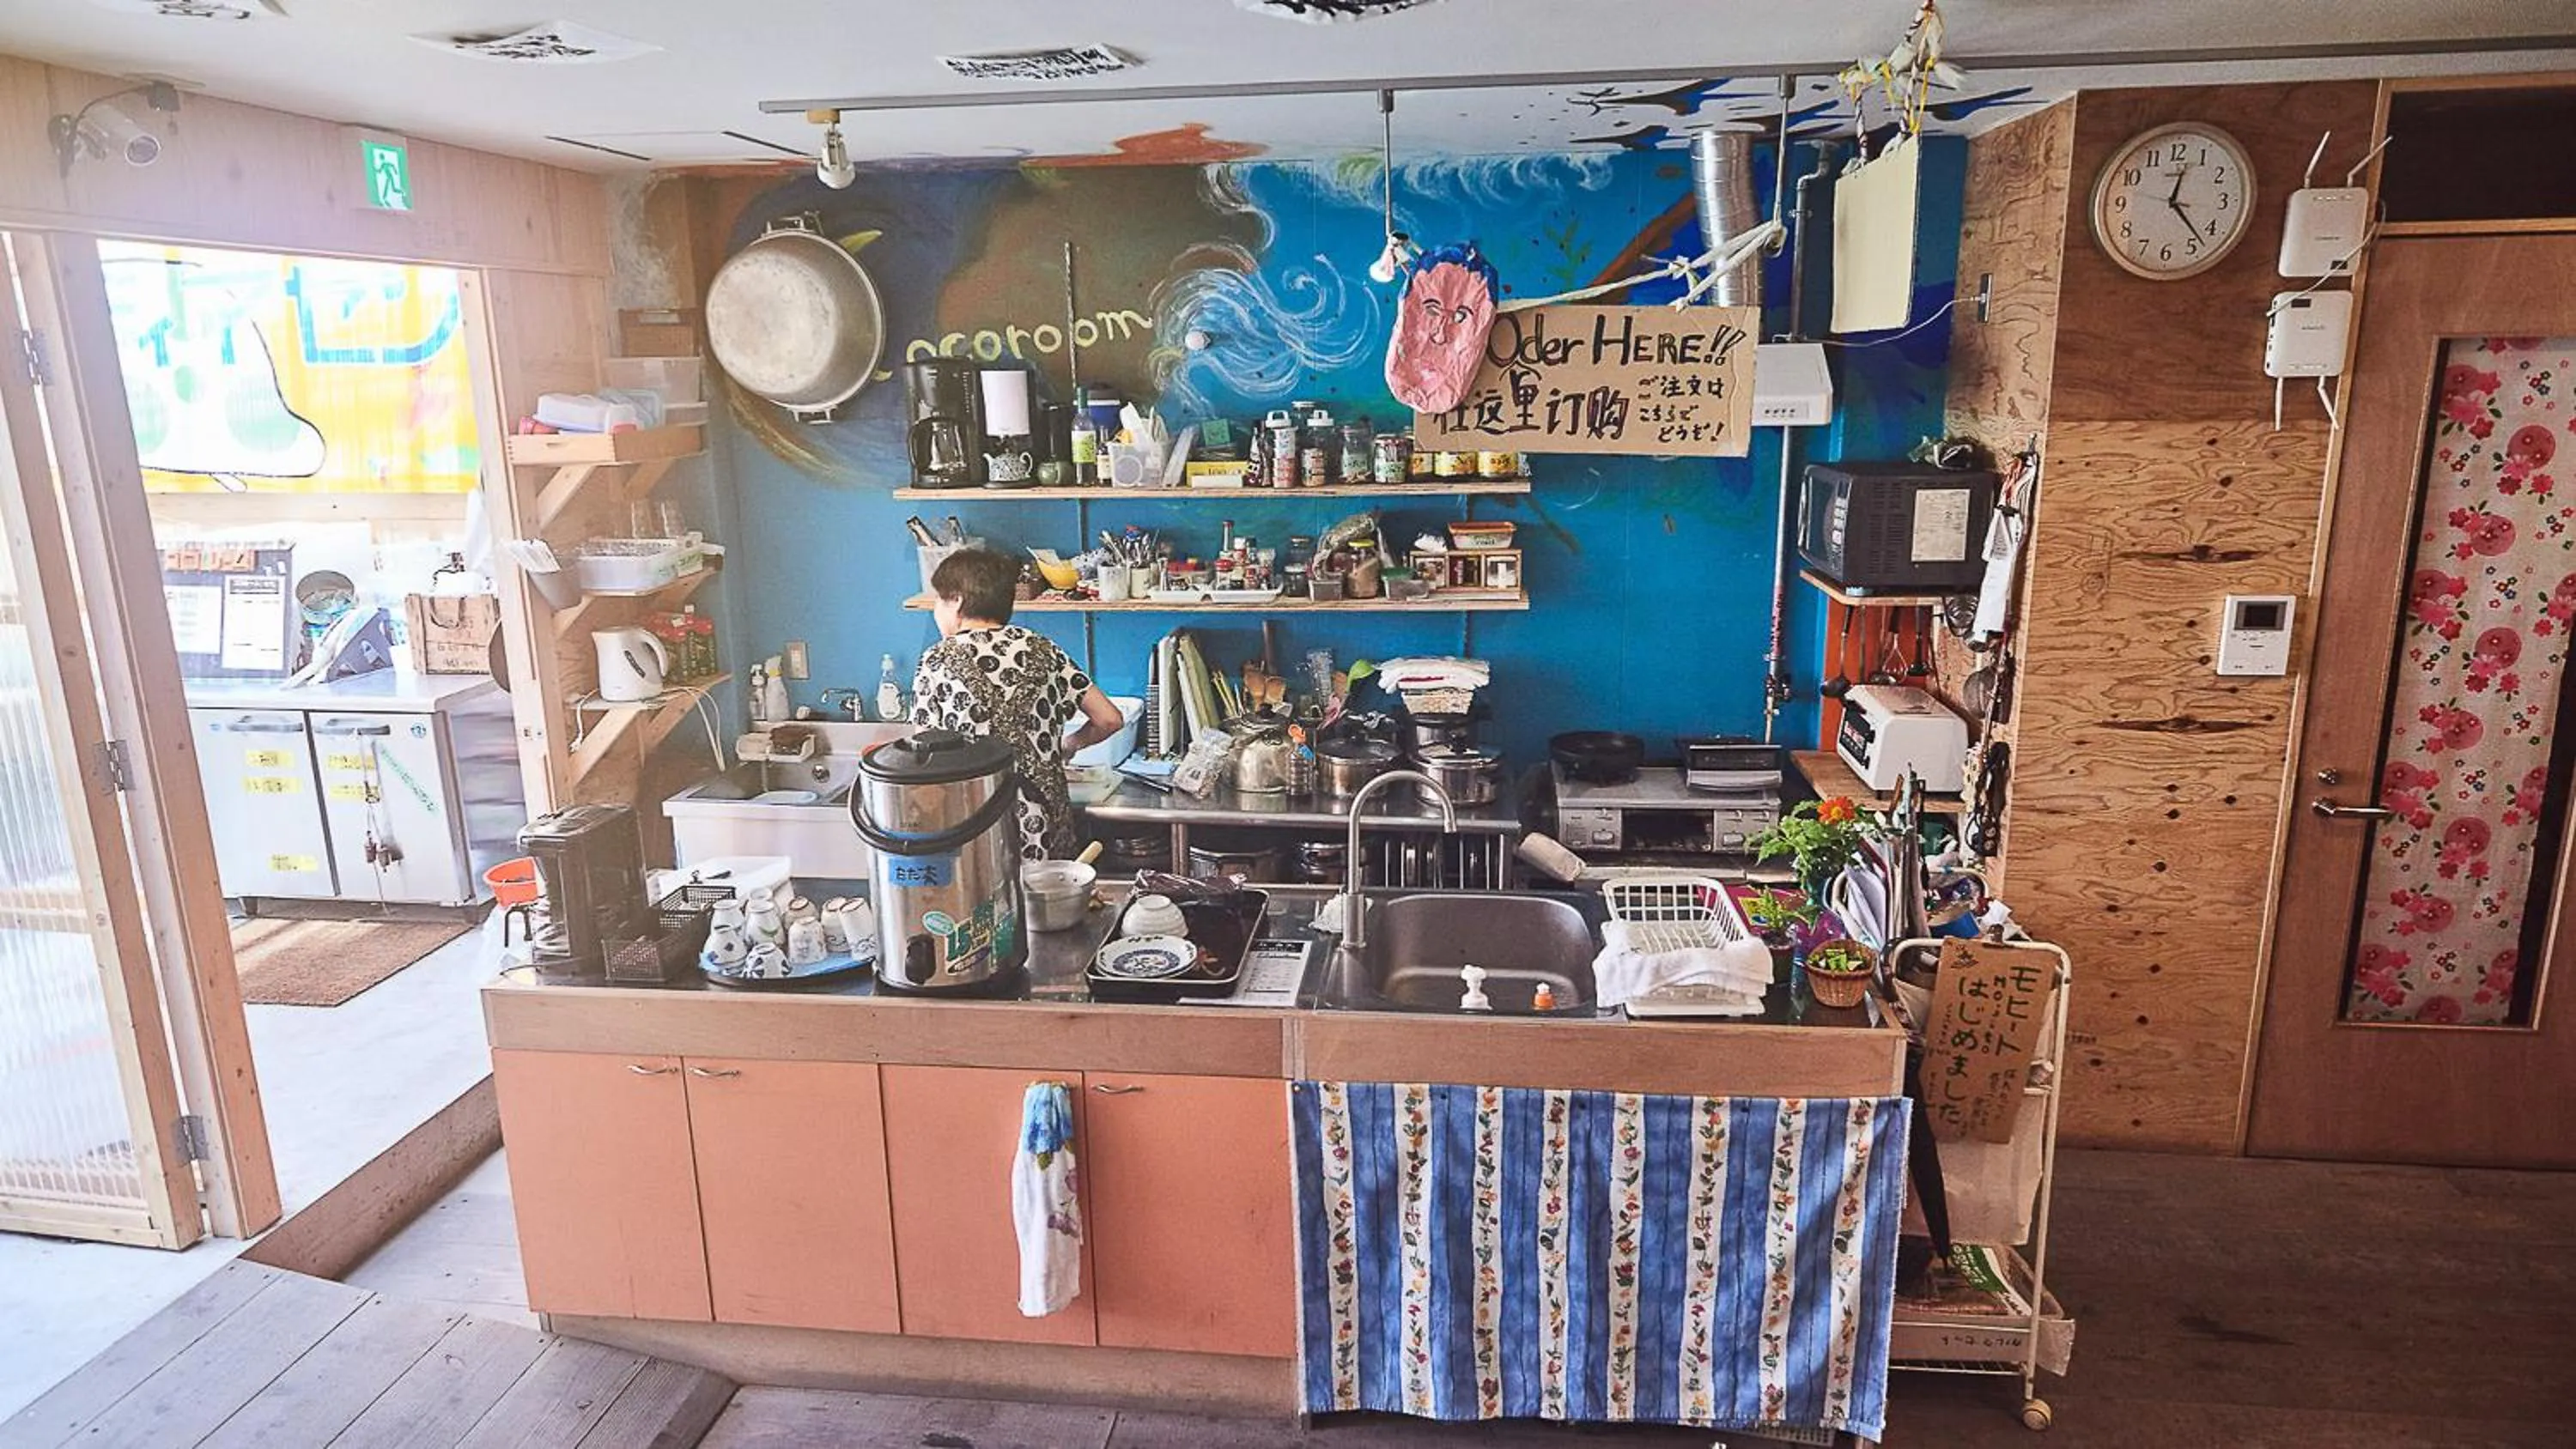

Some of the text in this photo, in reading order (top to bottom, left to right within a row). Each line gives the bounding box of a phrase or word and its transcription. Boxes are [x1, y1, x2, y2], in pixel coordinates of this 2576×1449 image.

[2147, 150, 2160, 167] 11
[2170, 144, 2186, 161] 12
[2199, 149, 2206, 166] 1
[2123, 169, 2142, 186] 10
[2214, 167, 2225, 184] 2
[2115, 196, 2126, 213] 9
[2218, 192, 2228, 209] 3
[2120, 221, 2132, 238] 8
[2205, 219, 2216, 236] 4
[2139, 240, 2149, 256] 7
[2160, 243, 2172, 261] 6
[2184, 239, 2197, 255] 5
[1637, 374, 1724, 399] ご注文は
[1995, 966, 2043, 1056] モヒート
[1938, 977, 1990, 1124] はじめました
